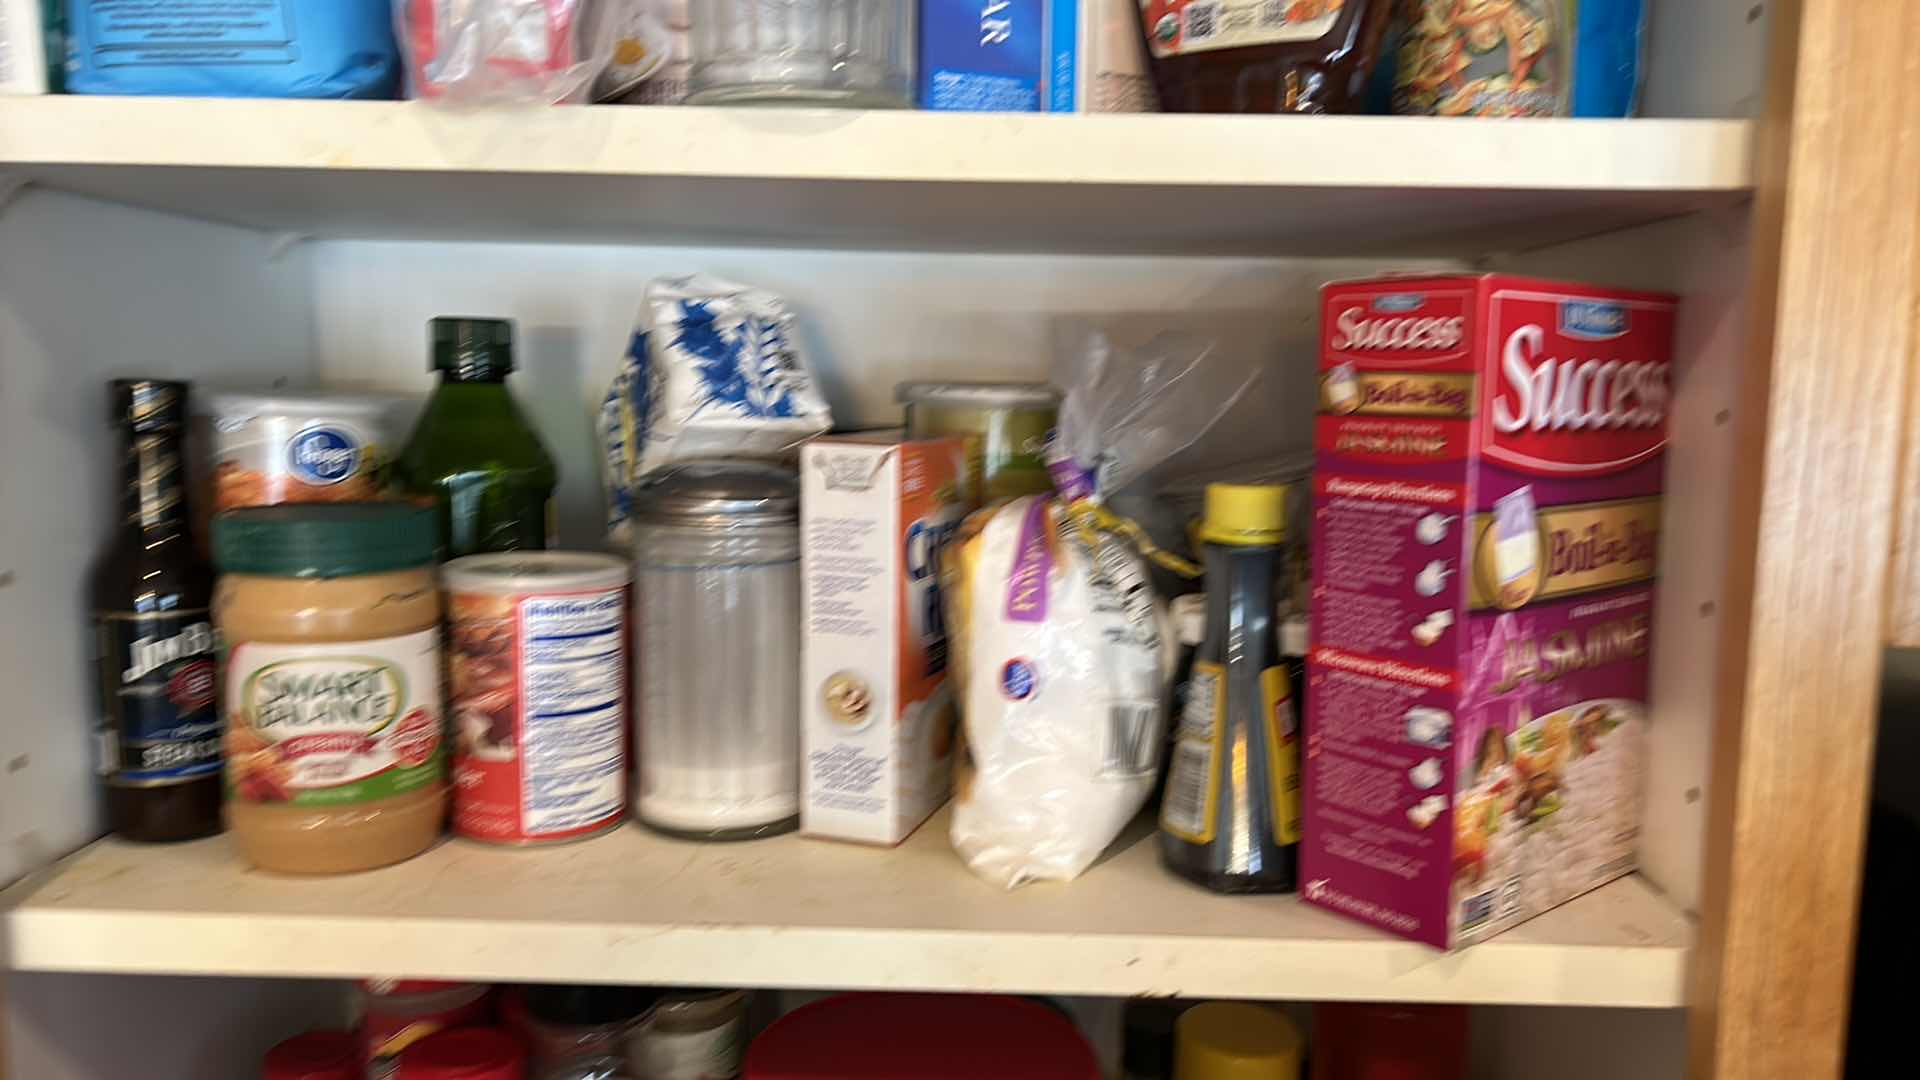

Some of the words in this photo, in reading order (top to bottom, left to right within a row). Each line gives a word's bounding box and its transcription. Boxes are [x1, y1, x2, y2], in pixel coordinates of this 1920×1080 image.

[1332, 306, 1465, 351] Success
[260, 666, 388, 703] SMART
[256, 697, 389, 729] BALANCE
